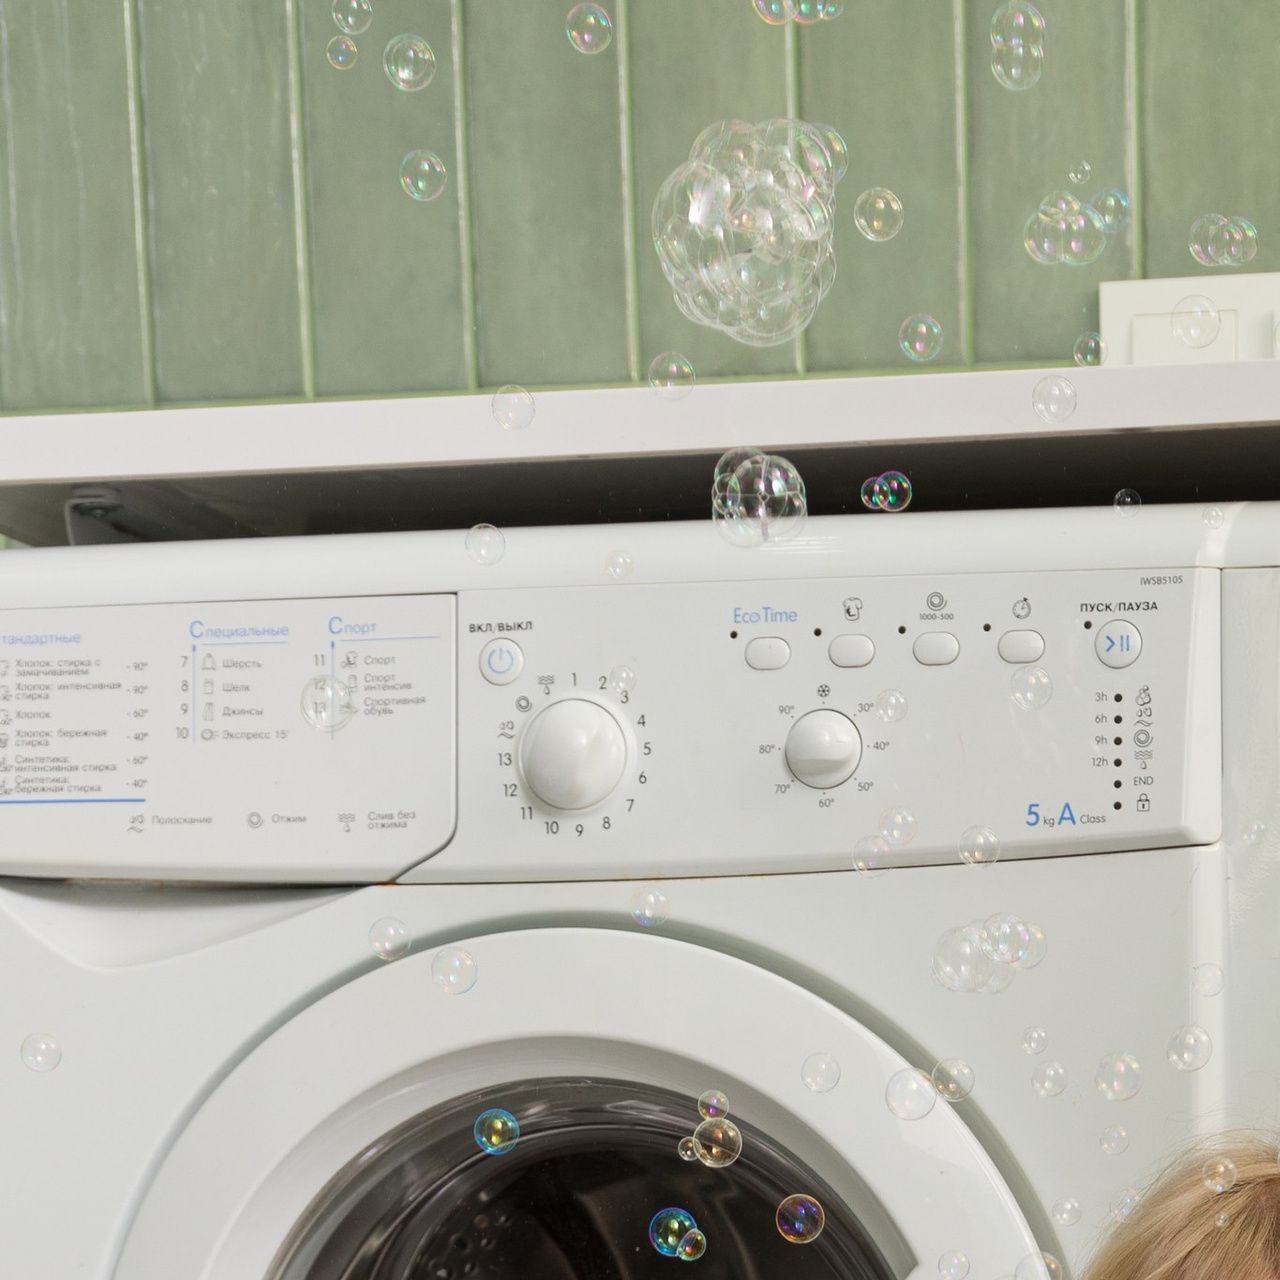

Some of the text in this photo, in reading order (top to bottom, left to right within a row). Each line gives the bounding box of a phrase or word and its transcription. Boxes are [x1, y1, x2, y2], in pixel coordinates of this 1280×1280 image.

[1080, 601, 1159, 613] ПУСК/ПАУЗА
[189, 620, 290, 639] Специальные
[328, 616, 377, 635] Спорт
[468, 620, 533, 633] ВКЛ/ВЫКЛ
[181, 655, 188, 668] 7
[222, 659, 262, 669] Шерсть
[314, 654, 325, 667] 11
[363, 655, 396, 665] Спорт
[363, 673, 396, 684] Спорт
[572, 673, 577, 686] 1
[600, 676, 607, 689] 2
[181, 680, 189, 692] 8
[222, 682, 250, 692] Шелк
[364, 683, 412, 691] интенсив
[621, 690, 629, 704] 3
[1095, 692, 1108, 702] 3h
[181, 703, 188, 715] 9
[222, 706, 263, 716] Джинсы
[637, 714, 646, 727] 4
[1095, 713, 1108, 724] 6h
[176, 727, 189, 739] 10
[222, 729, 271, 740] Экспресс
[1094, 735, 1108, 746] 9h
[643, 742, 652, 756] 5
[498, 753, 512, 766] 13
[1092, 757, 1108, 767] 12h
[638, 771, 647, 784] 6
[1133, 776, 1154, 786] END
[503, 784, 518, 797] 12
[626, 799, 635, 812] 7
[272, 813, 307, 823] Отжим
[521, 807, 533, 820] 11
[1026, 802, 1106, 828] 5 kg A Class
[152, 815, 213, 825] Полоскание
[602, 817, 611, 829] 8
[544, 821, 559, 834] 10
[575, 824, 584, 837] 9
